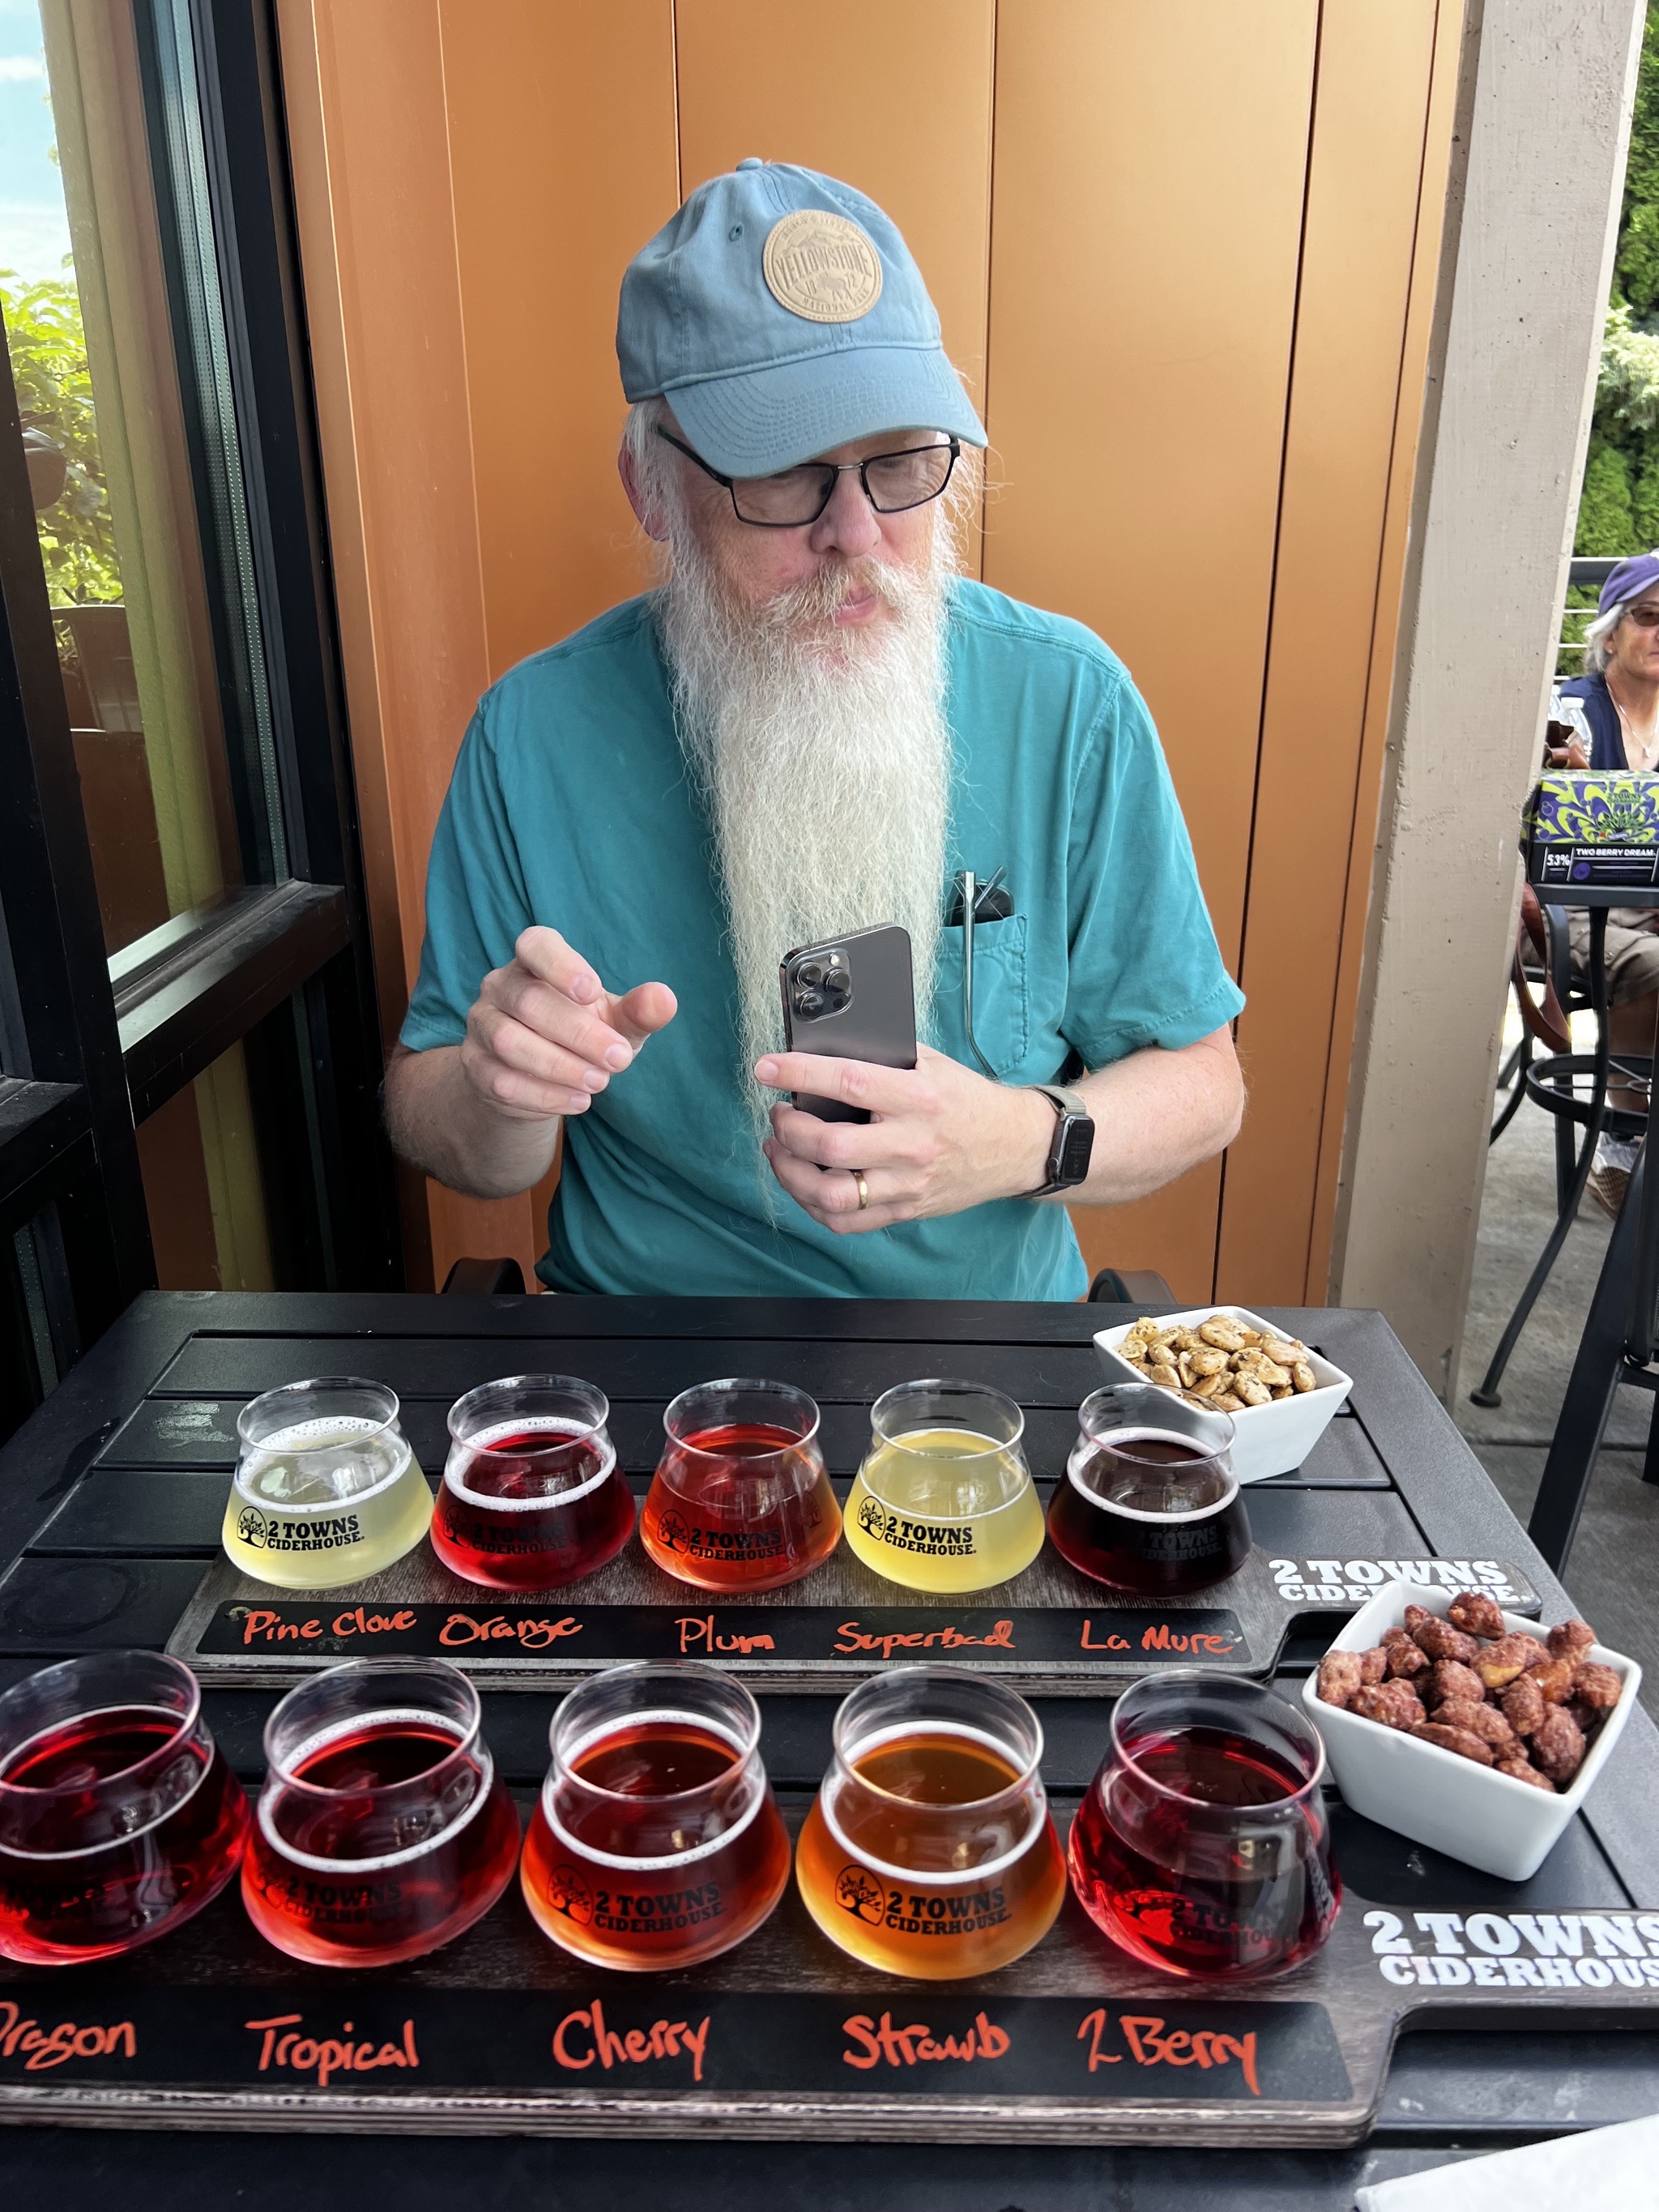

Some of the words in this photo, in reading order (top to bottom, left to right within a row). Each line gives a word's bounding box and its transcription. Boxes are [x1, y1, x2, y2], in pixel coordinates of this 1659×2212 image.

[775, 245, 872, 291] YELLOWSTONE
[802, 297, 850, 312] NATIONAL
[1576, 848, 1596, 856] TWO
[1596, 848, 1623, 856] BERRY
[268, 1520, 281, 1539] 2
[283, 1514, 359, 1539] TOWNS
[690, 1527, 702, 1545] 2
[703, 1527, 781, 1548] TOWNS
[885, 1517, 898, 1533] 2
[901, 1522, 973, 1545] TOWNS
[1149, 1525, 1218, 1549] TOWNS
[1140, 1541, 1219, 1561] IDERHOUSE
[1269, 1559, 1304, 1584] 2
[1306, 1560, 1508, 1586] TOWNS
[244, 1610, 323, 1645] Pine
[333, 1607, 417, 1638] Clove
[439, 1612, 583, 1649] Orange
[674, 1615, 775, 1654] Plum
[1080, 1620, 1131, 1650] La
[1141, 1625, 1235, 1655] Mure
[288, 1876, 300, 1898] 2
[595, 1891, 610, 1914] 2
[616, 1881, 720, 1918] TOWNS
[888, 1891, 903, 1915] 2
[908, 1885, 1005, 1920] TOWNS
[1363, 1911, 1408, 1955] 2
[245, 2013, 420, 2086] Tropical
[553, 1999, 710, 2082] Cherry
[1077, 2008, 1122, 2072] 2
[1120, 2016, 1261, 2095] Berry
